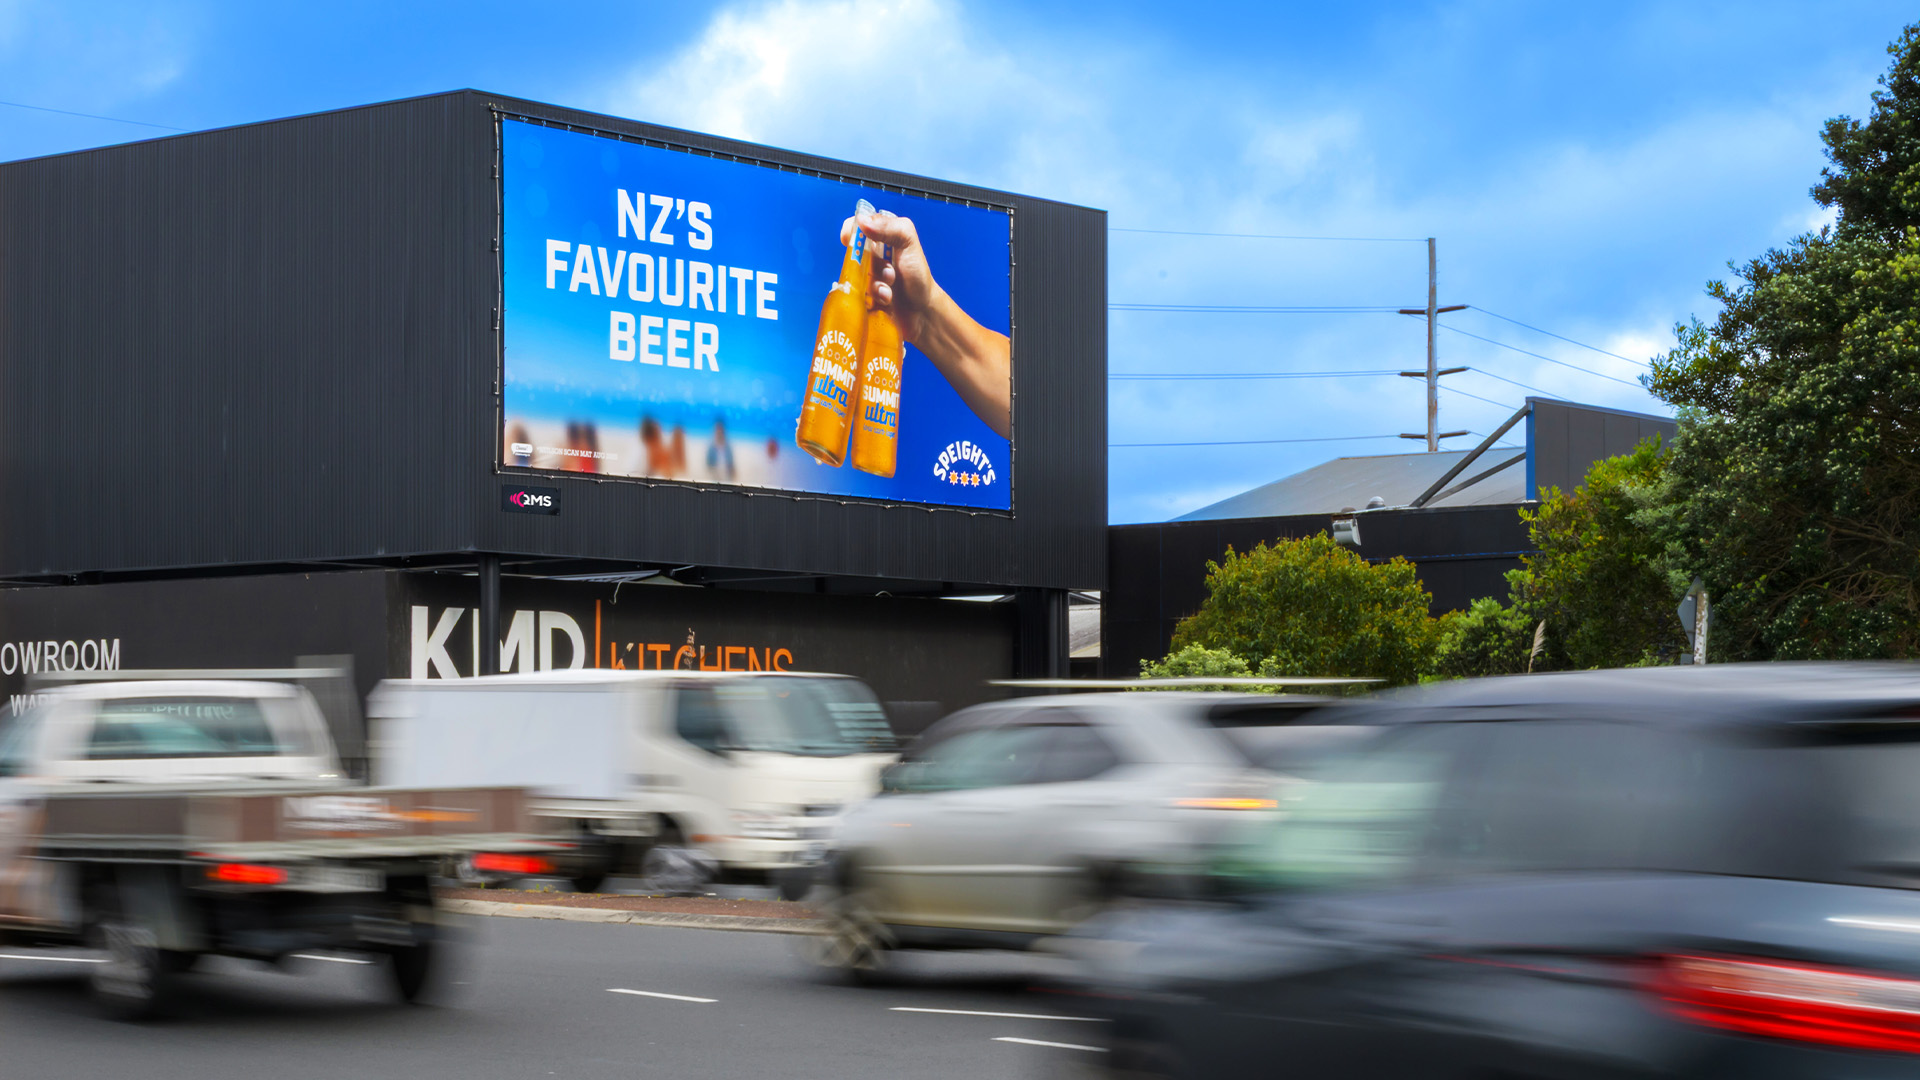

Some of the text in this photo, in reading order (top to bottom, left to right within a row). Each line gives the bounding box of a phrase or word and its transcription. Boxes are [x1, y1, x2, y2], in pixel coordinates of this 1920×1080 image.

[545, 238, 779, 320] FAVOURITE
[609, 310, 720, 372] BEER
[817, 330, 857, 370] SPEIGHT'S
[812, 356, 856, 391] SUMMIT
[813, 375, 848, 407] ultra
[862, 385, 900, 408] SUMMIT
[865, 402, 896, 428] ultra
[563, 448, 580, 457] SCAN
[579, 450, 593, 459] MAT
[592, 451, 606, 460] AUG
[933, 440, 996, 486] SPEIGHT'S
[516, 491, 552, 507] QMS
